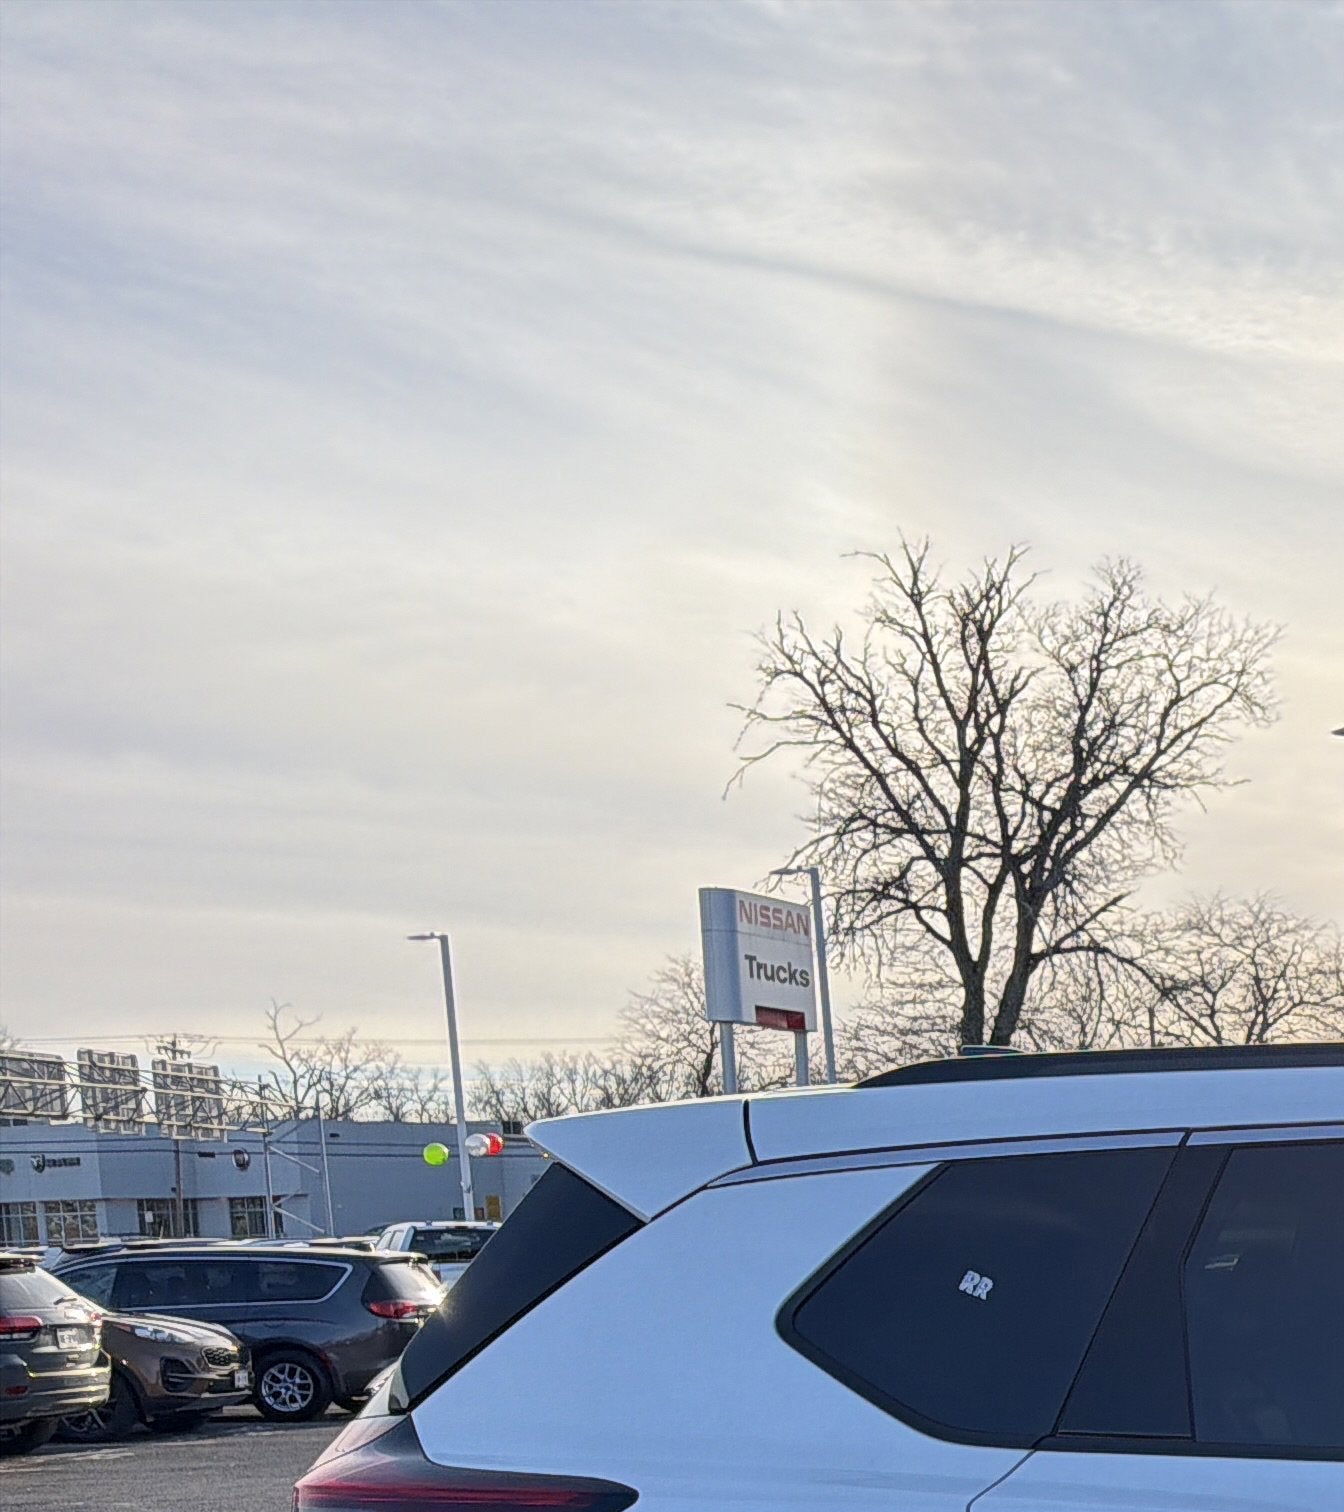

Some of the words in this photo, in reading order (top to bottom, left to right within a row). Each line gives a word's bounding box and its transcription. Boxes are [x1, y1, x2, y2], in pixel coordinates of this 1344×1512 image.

[739, 900, 810, 936] NISSAN
[744, 954, 811, 988] Trucks
[958, 1270, 994, 1301] RR
